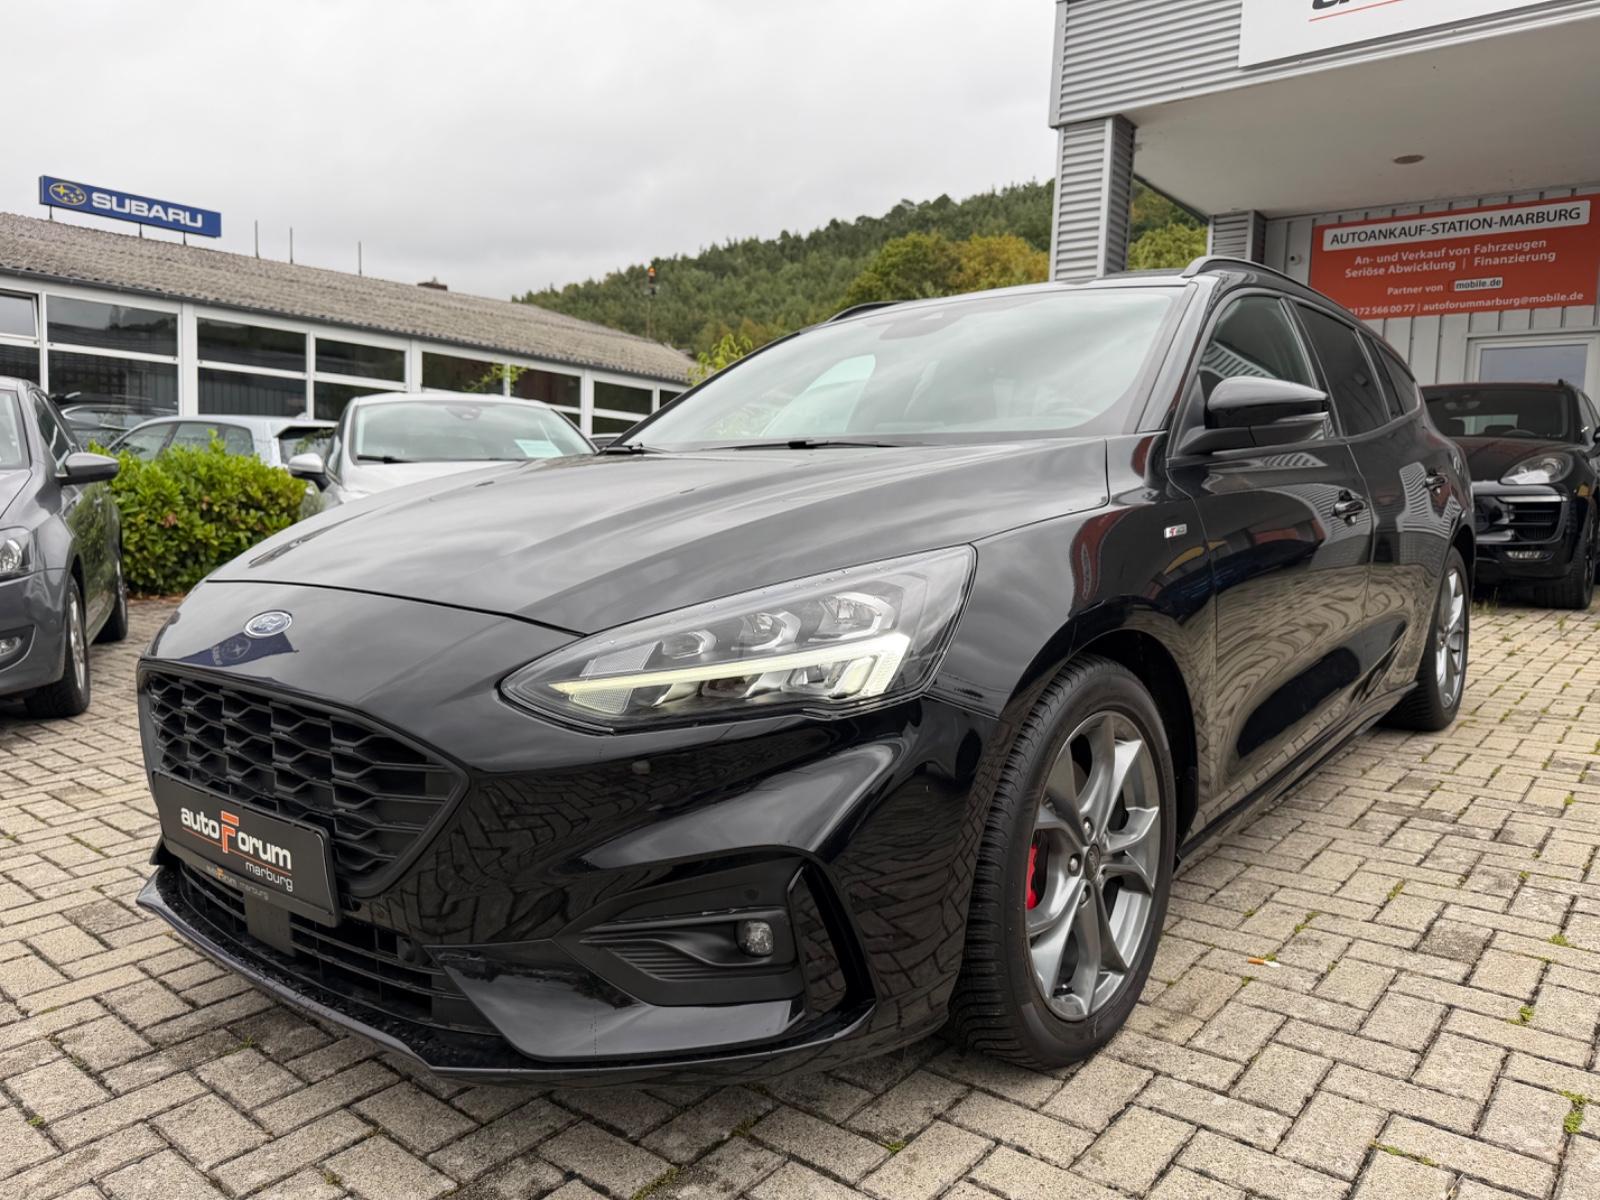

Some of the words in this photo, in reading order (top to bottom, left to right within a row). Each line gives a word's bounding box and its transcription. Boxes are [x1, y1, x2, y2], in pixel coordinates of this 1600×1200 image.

[91, 192, 203, 228] SUBARU
[1330, 207, 1581, 245] AUTOANKAUF-STATION-MARBURG
[1344, 267, 1385, 279] Seriöse
[1387, 261, 1456, 274] Abwicklung
[1473, 251, 1557, 267] Finanzierung
[1354, 256, 1374, 265] An-
[1377, 252, 1398, 263] und
[1401, 248, 1446, 261] Verkauf
[1449, 247, 1470, 256] von
[1473, 240, 1547, 254] Fahrzeugen
[1387, 286, 1422, 296] Partner
[1425, 284, 1443, 292] von
[1456, 278, 1502, 290] mobile.de
[1423, 291, 1584, 311] autoforummarburg@mobile.de
[245, 861, 293, 892] marburg
